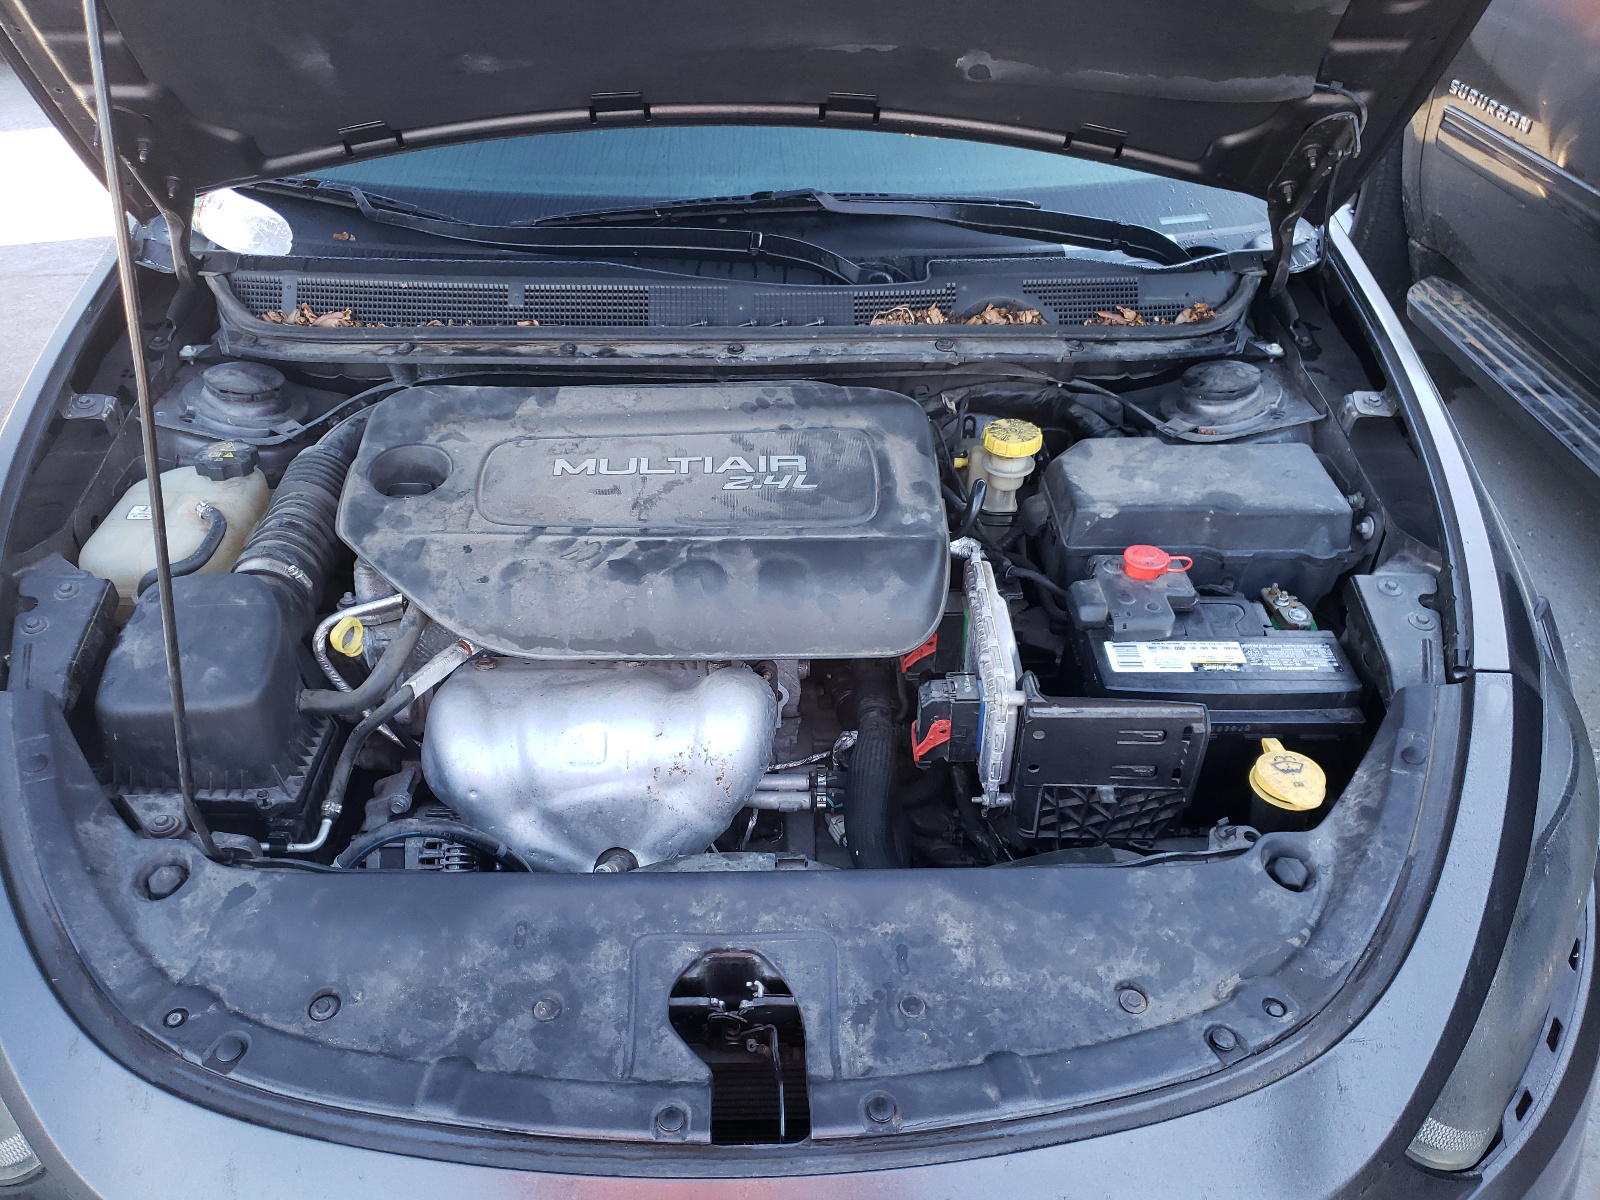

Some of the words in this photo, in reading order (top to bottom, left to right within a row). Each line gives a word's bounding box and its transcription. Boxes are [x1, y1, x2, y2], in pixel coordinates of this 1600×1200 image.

[1448, 79, 1533, 134] SUBURBAN
[553, 455, 808, 477] MULTIAIR
[722, 474, 819, 491] 2.4L
